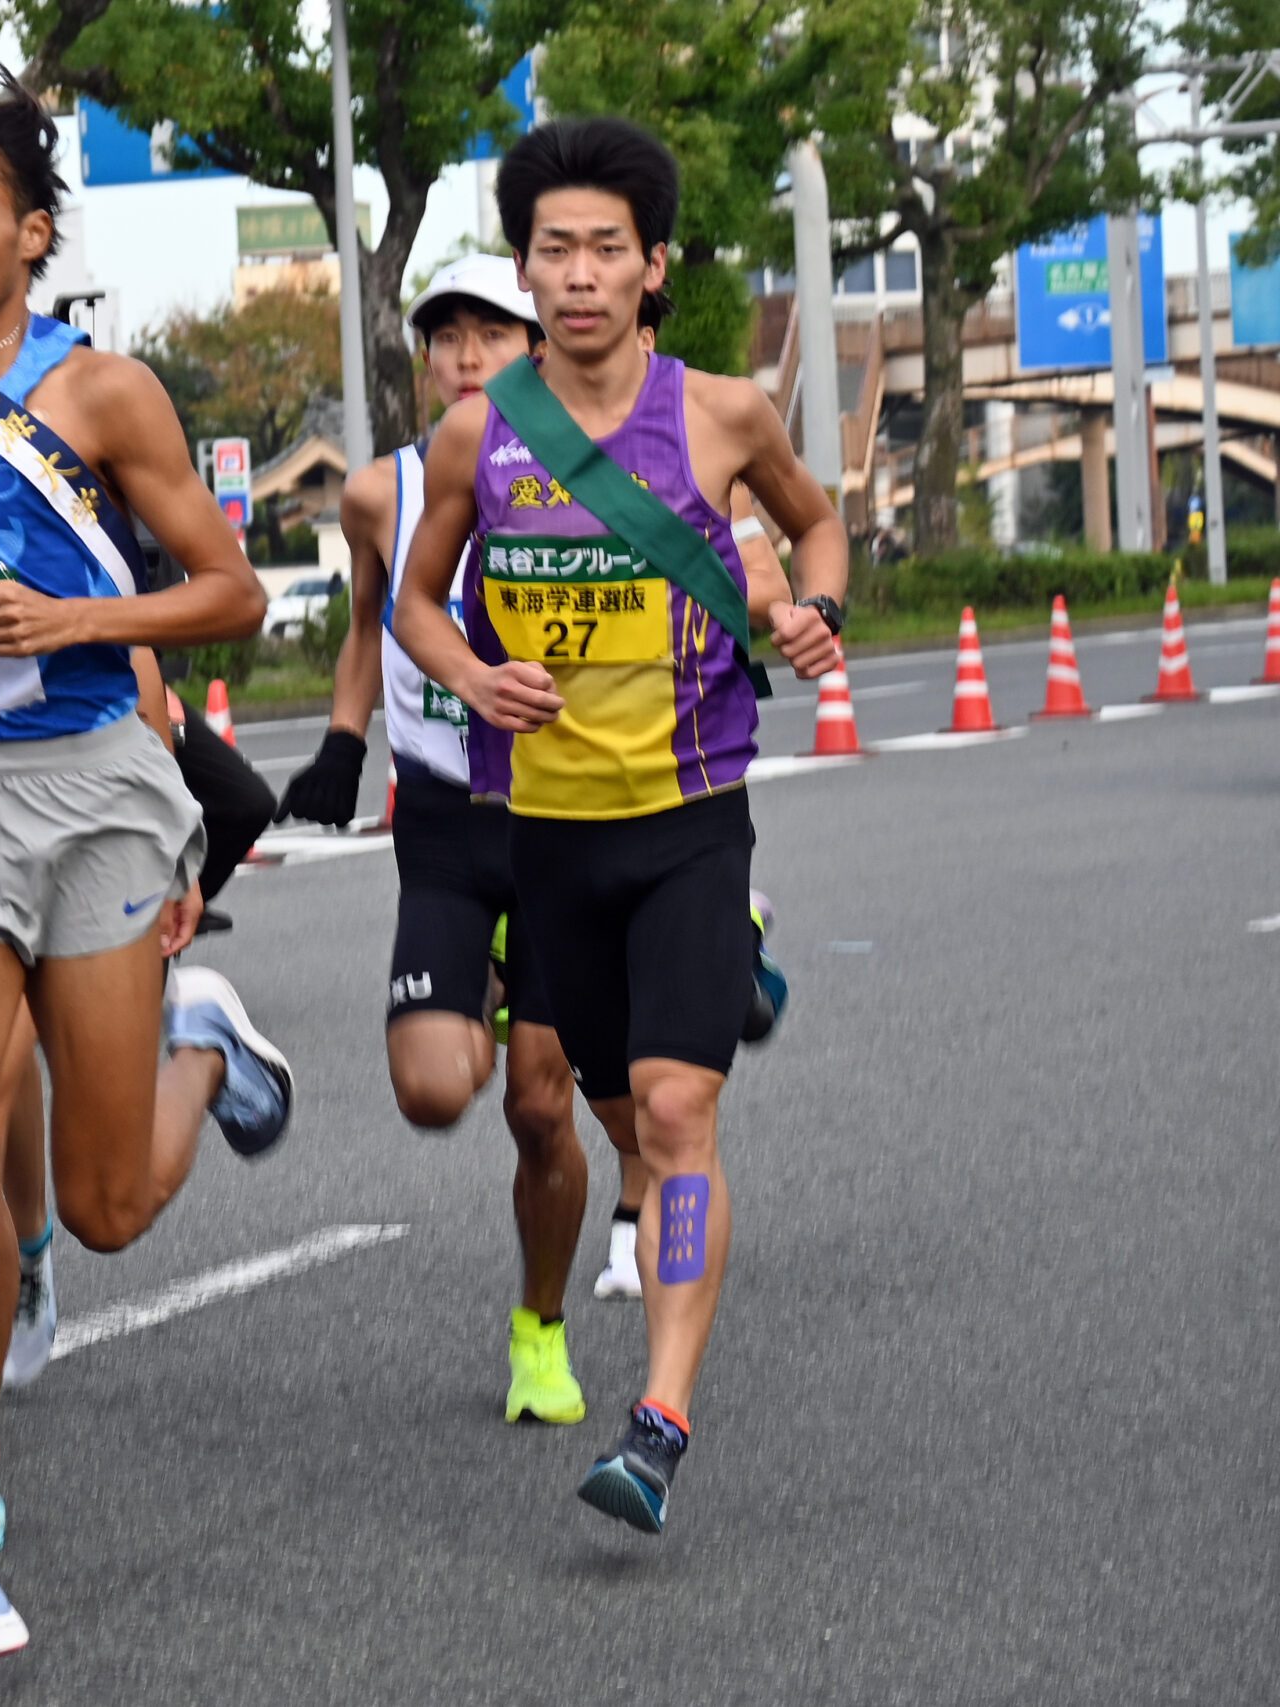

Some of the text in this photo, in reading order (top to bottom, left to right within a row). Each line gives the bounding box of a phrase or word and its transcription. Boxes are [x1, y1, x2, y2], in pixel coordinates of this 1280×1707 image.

[499, 584, 646, 615] 東海学連選抜
[543, 620, 598, 658] 27
